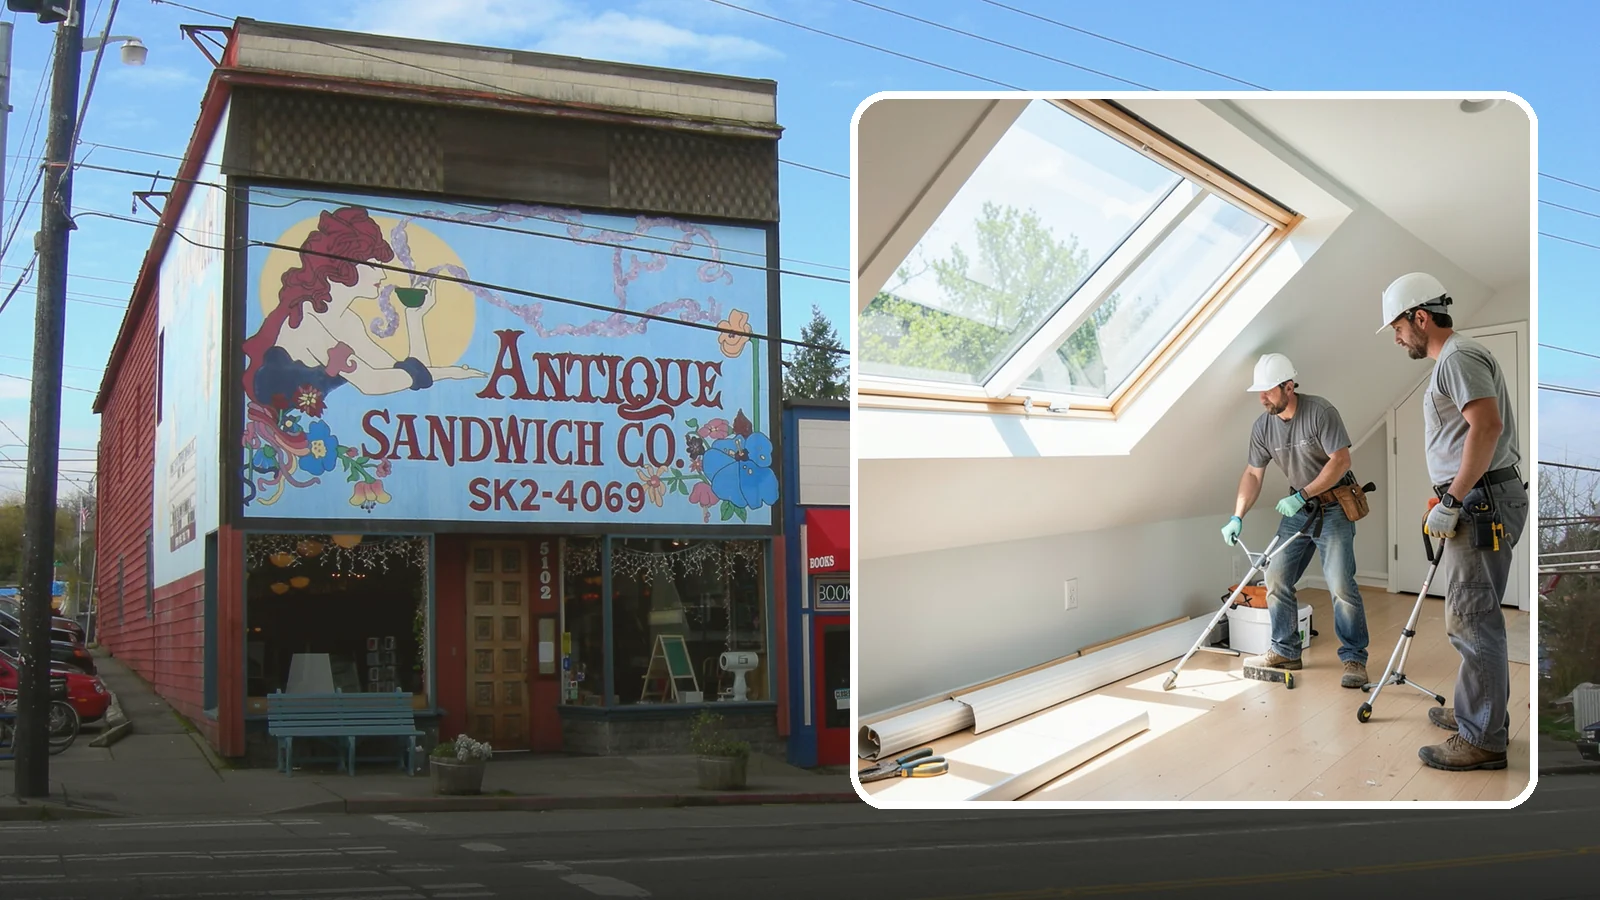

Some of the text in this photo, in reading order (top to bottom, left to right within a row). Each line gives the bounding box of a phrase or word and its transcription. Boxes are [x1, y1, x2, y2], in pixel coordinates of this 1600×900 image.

[475, 329, 723, 421] ANTIQUE
[361, 408, 684, 468] SANDWICH CO.
[469, 477, 645, 513] SK2-4069
[540, 541, 552, 600] 5102
[809, 555, 835, 569] BOOKS
